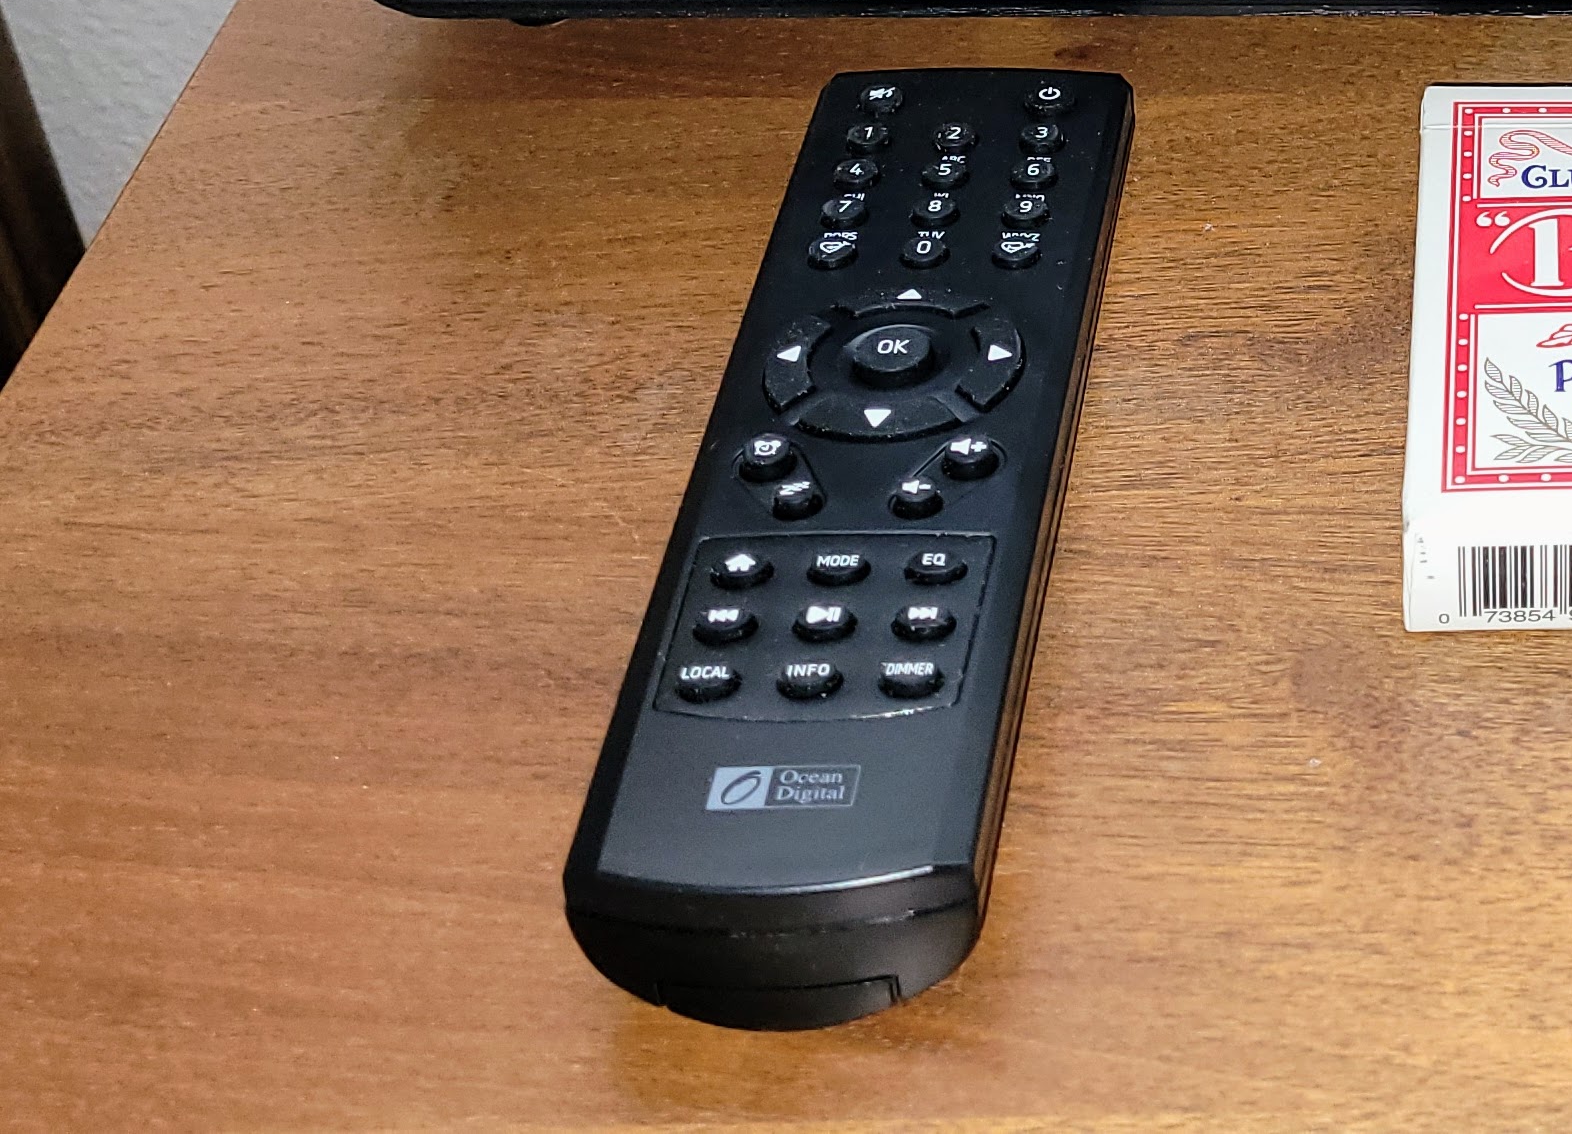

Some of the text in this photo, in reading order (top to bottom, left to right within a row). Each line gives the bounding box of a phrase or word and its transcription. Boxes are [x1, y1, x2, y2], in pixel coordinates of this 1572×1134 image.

[864, 126, 874, 139] 1
[948, 126, 962, 139] 2
[1035, 126, 1048, 139] 3
[850, 164, 862, 176] 4
[938, 163, 952, 175] 5
[1027, 163, 1040, 176] 6
[838, 200, 852, 212] 7
[927, 200, 942, 212] 8
[1019, 200, 1033, 212] 9
[916, 240, 931, 254] 0
[877, 339, 910, 355] OK
[816, 555, 860, 567] MODE
[922, 553, 946, 566] EQ
[1438, 613, 1450, 625] 0
[1487, 608, 1555, 624] 73854
[680, 665, 730, 679] LOCAL
[786, 663, 830, 677] INFO
[885, 662, 934, 676] DIMMER
[779, 770, 843, 784] Ocean
[776, 784, 845, 804] Digital
